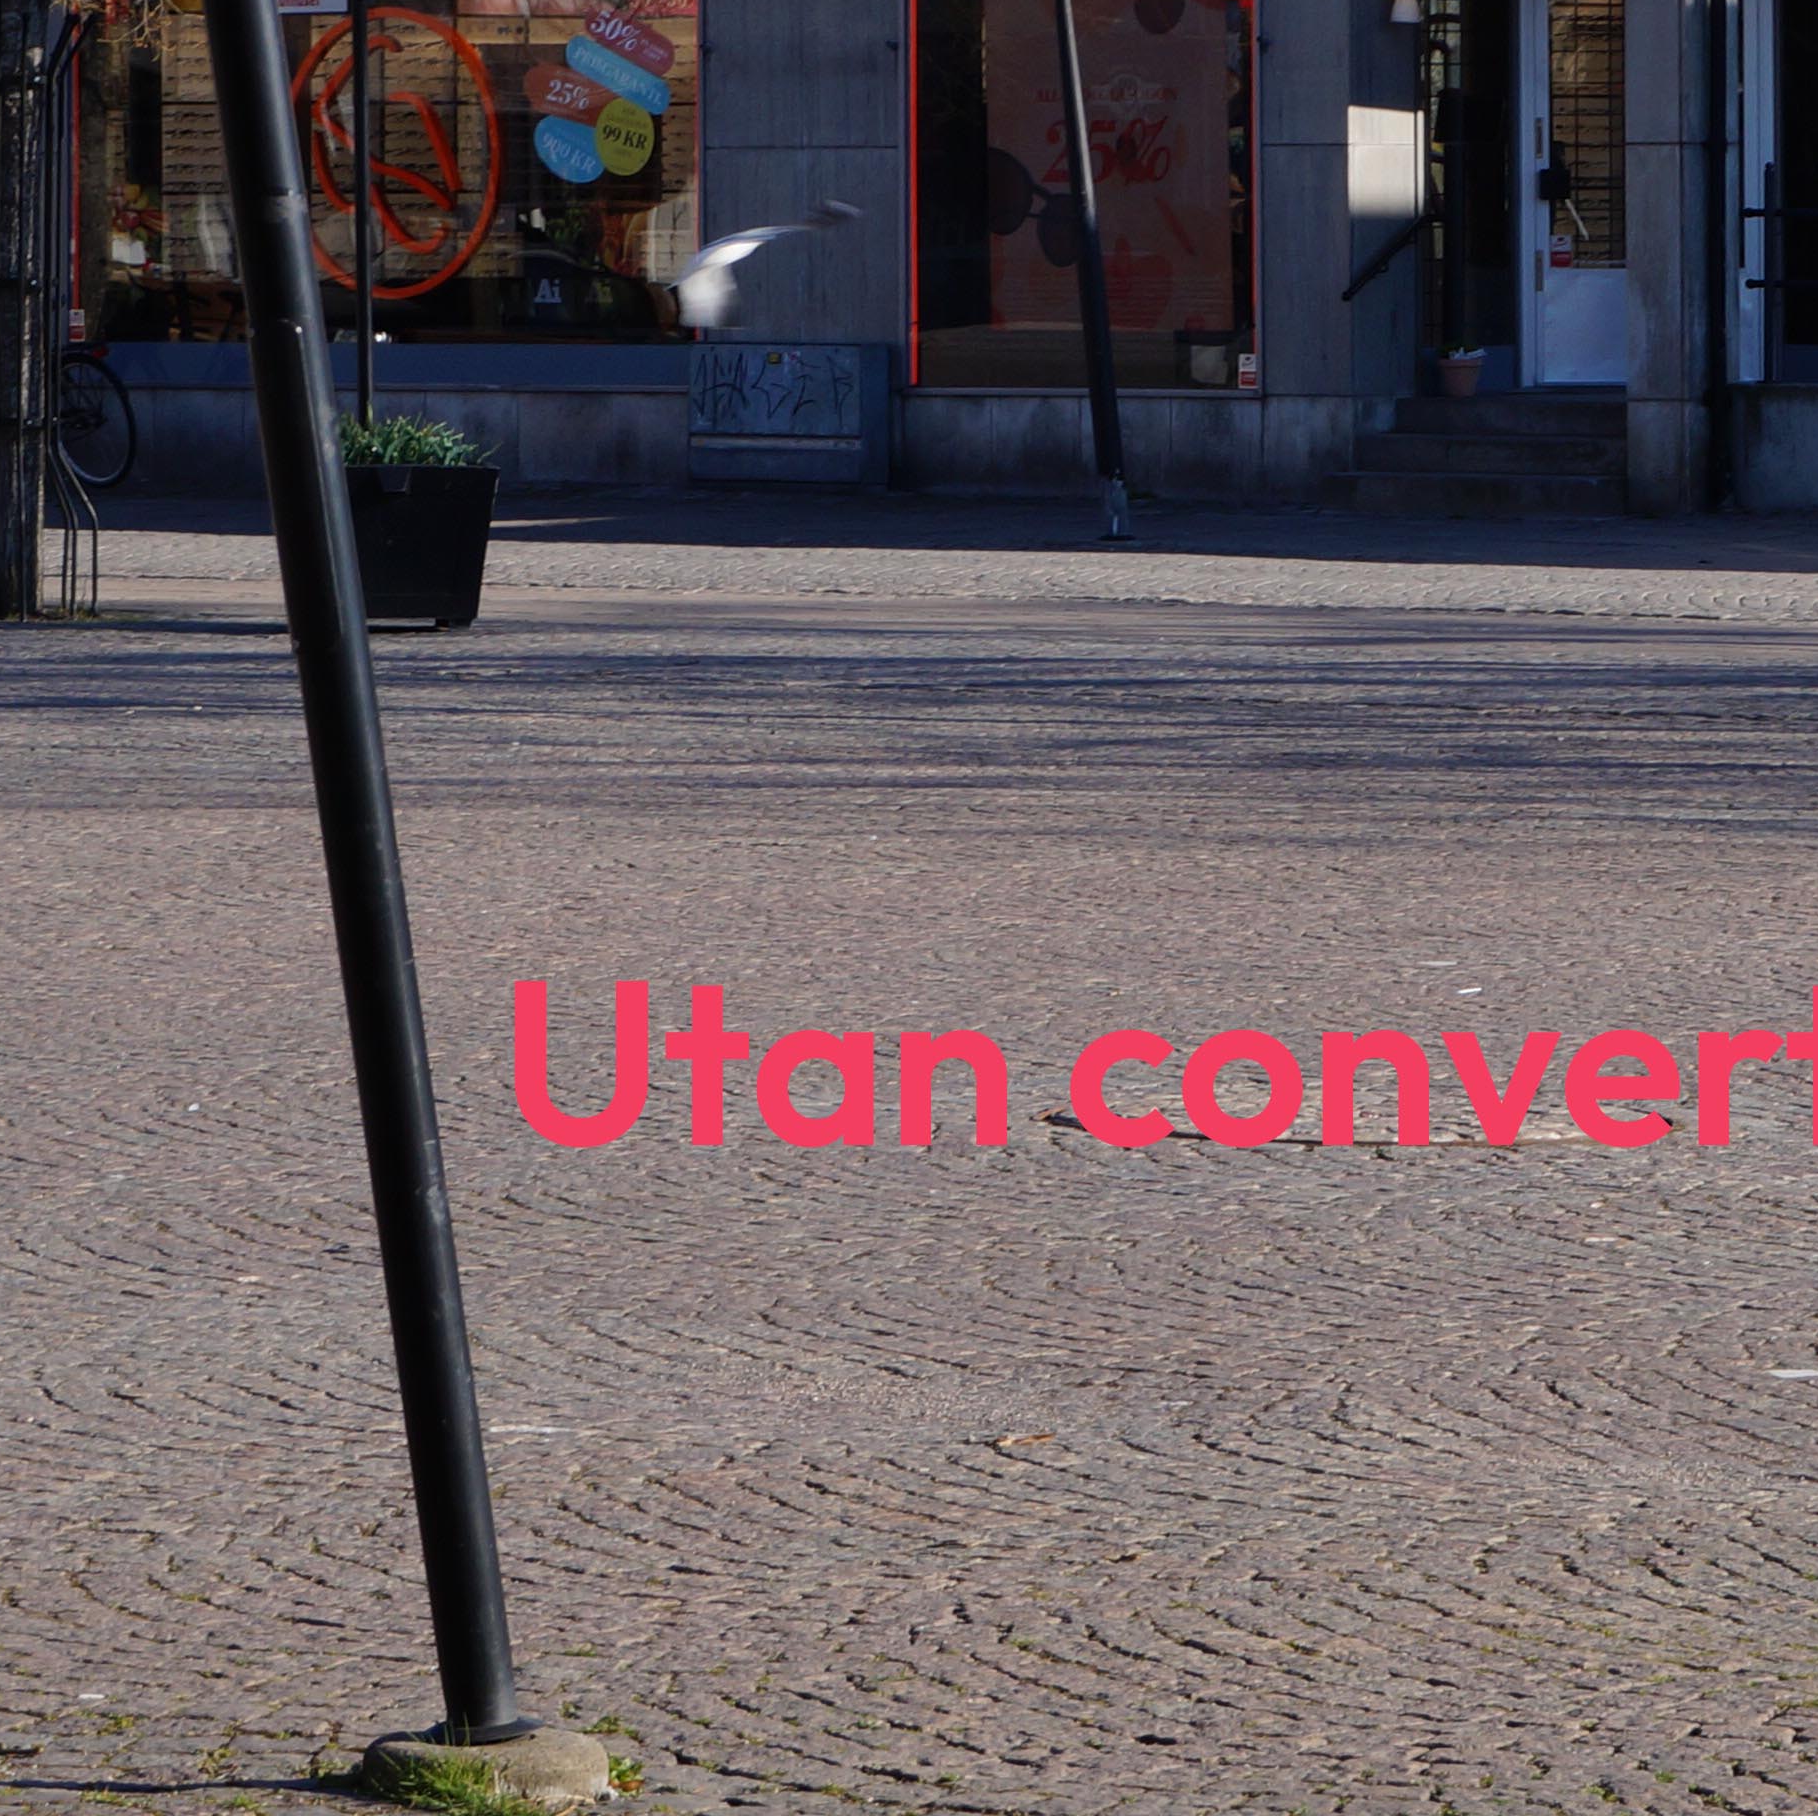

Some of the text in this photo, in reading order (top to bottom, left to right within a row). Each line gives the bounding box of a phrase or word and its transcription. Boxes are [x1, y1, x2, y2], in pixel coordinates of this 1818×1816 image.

[590, 10, 642, 52] 50%
[545, 79, 590, 110] 25%
[602, 124, 648, 151] 99 KR
